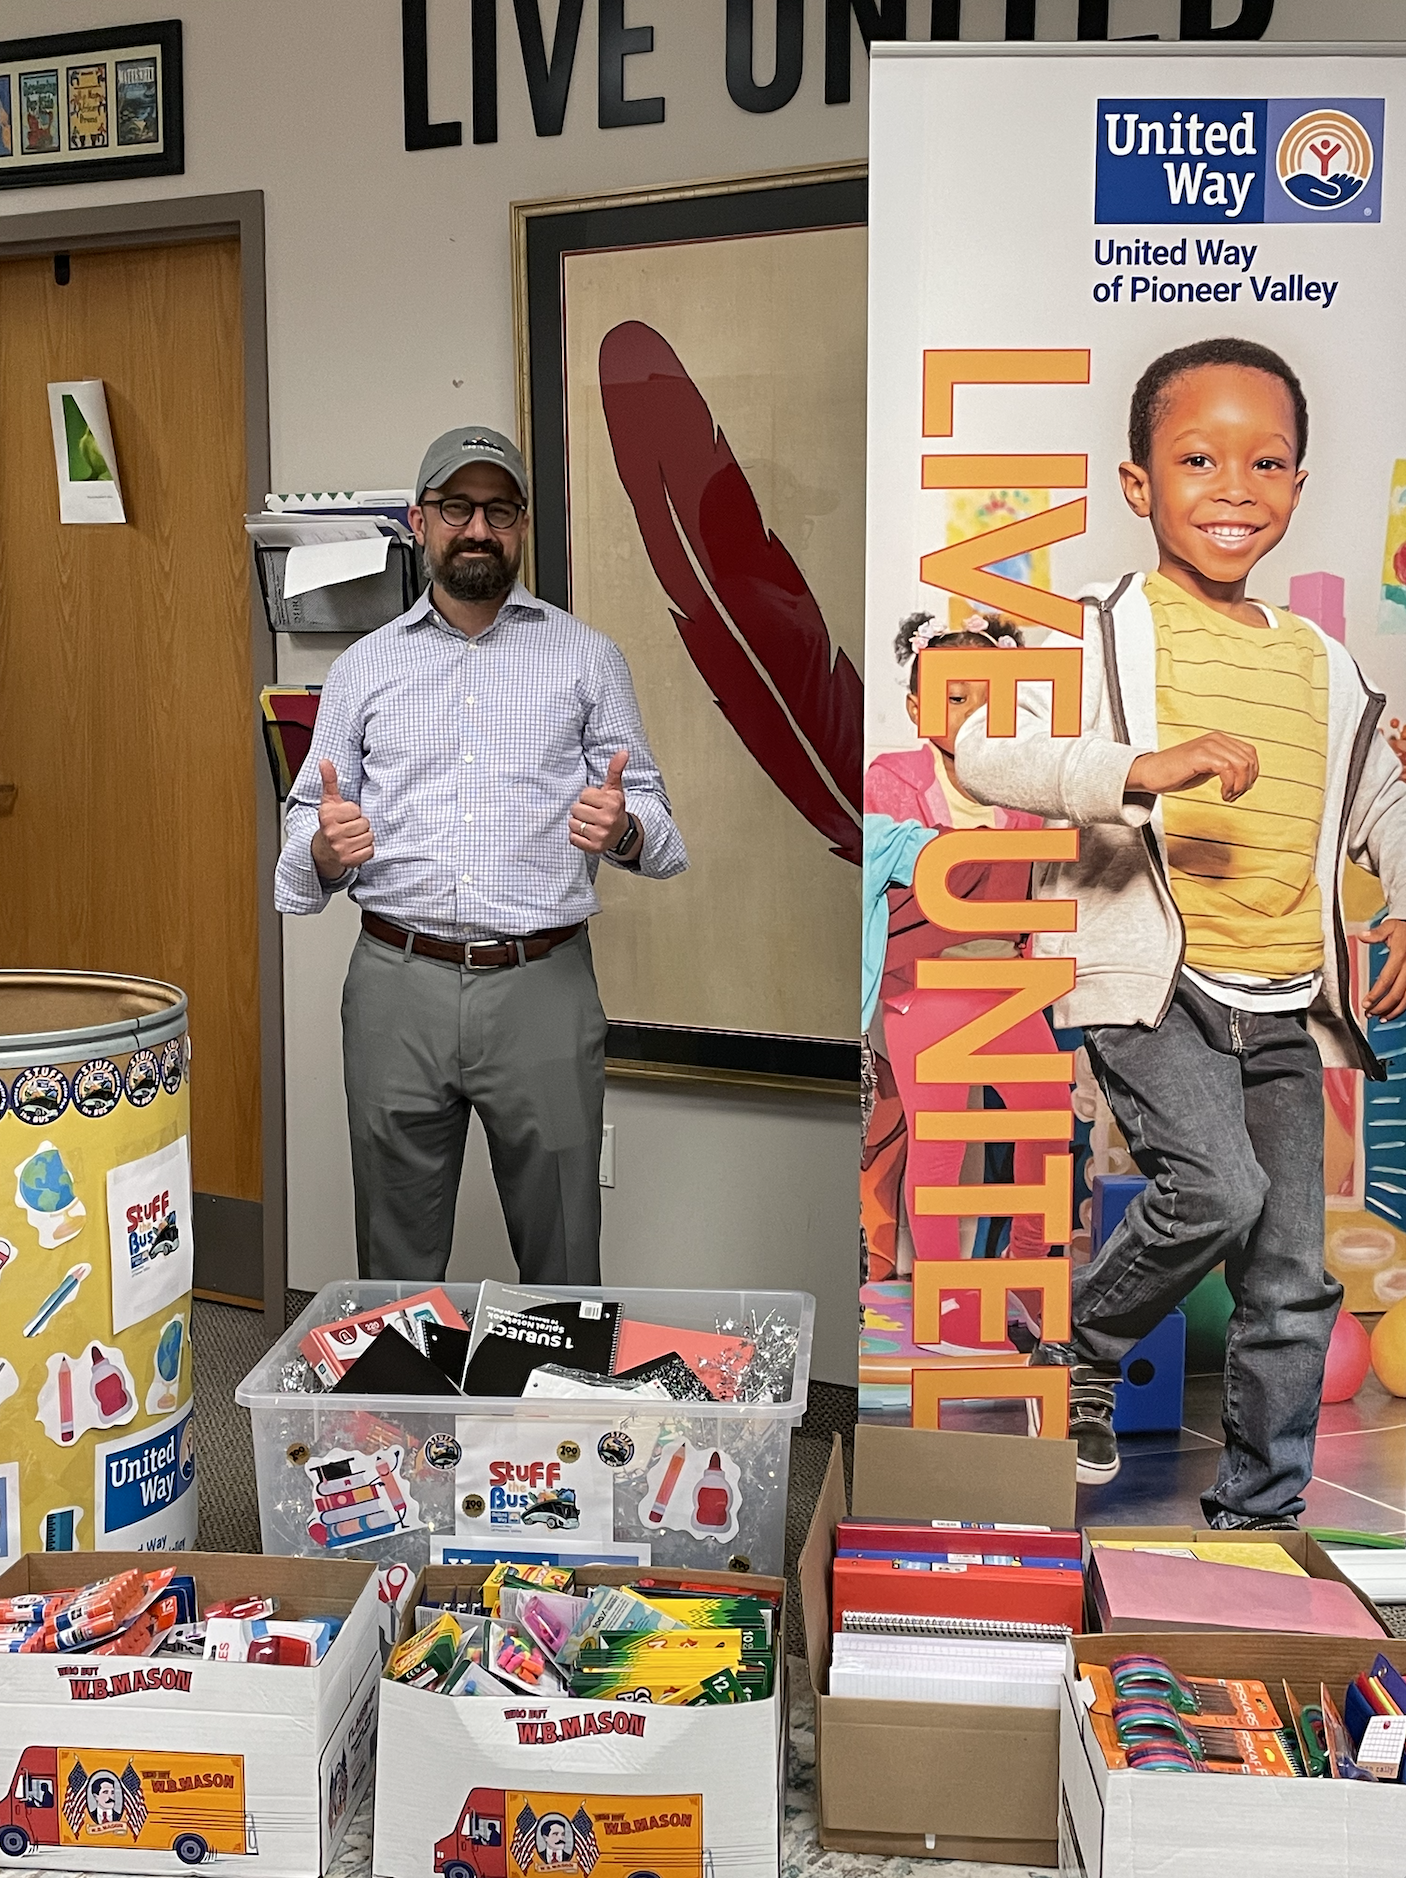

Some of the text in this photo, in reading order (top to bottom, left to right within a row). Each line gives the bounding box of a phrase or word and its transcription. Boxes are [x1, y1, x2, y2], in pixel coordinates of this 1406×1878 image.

[404, 0, 666, 151] LIVE
[1104, 111, 1257, 156] United
[1162, 162, 1256, 218] Way
[1094, 238, 1257, 272] United Way
[1092, 274, 1339, 308] of Pioneer Valley
[918, 348, 1091, 738] LIVE
[24, 1066, 63, 1081] STUFF
[81, 1059, 115, 1075] STUFF
[32, 1115, 50, 1123] BUS
[483, 1321, 574, 1350] 1 SUBJECT
[486, 1311, 565, 1334] Spiral Notebook
[109, 1435, 176, 1488] United
[140, 1471, 176, 1507] Way
[508, 1482, 527, 1493] the
[146, 1534, 167, 1551] Way
[160, 1566, 174, 1579] 12
[161, 1598, 174, 1613] 12
[70, 1667, 193, 1700] W.B.MASON
[711, 1675, 730, 1693] 12
[1231, 1681, 1260, 1727] FISKARS
[516, 1710, 646, 1745] W.B.MASON
[151, 1773, 234, 1794] W.B.MASON
[603, 1813, 692, 1835] W.B.MASON
